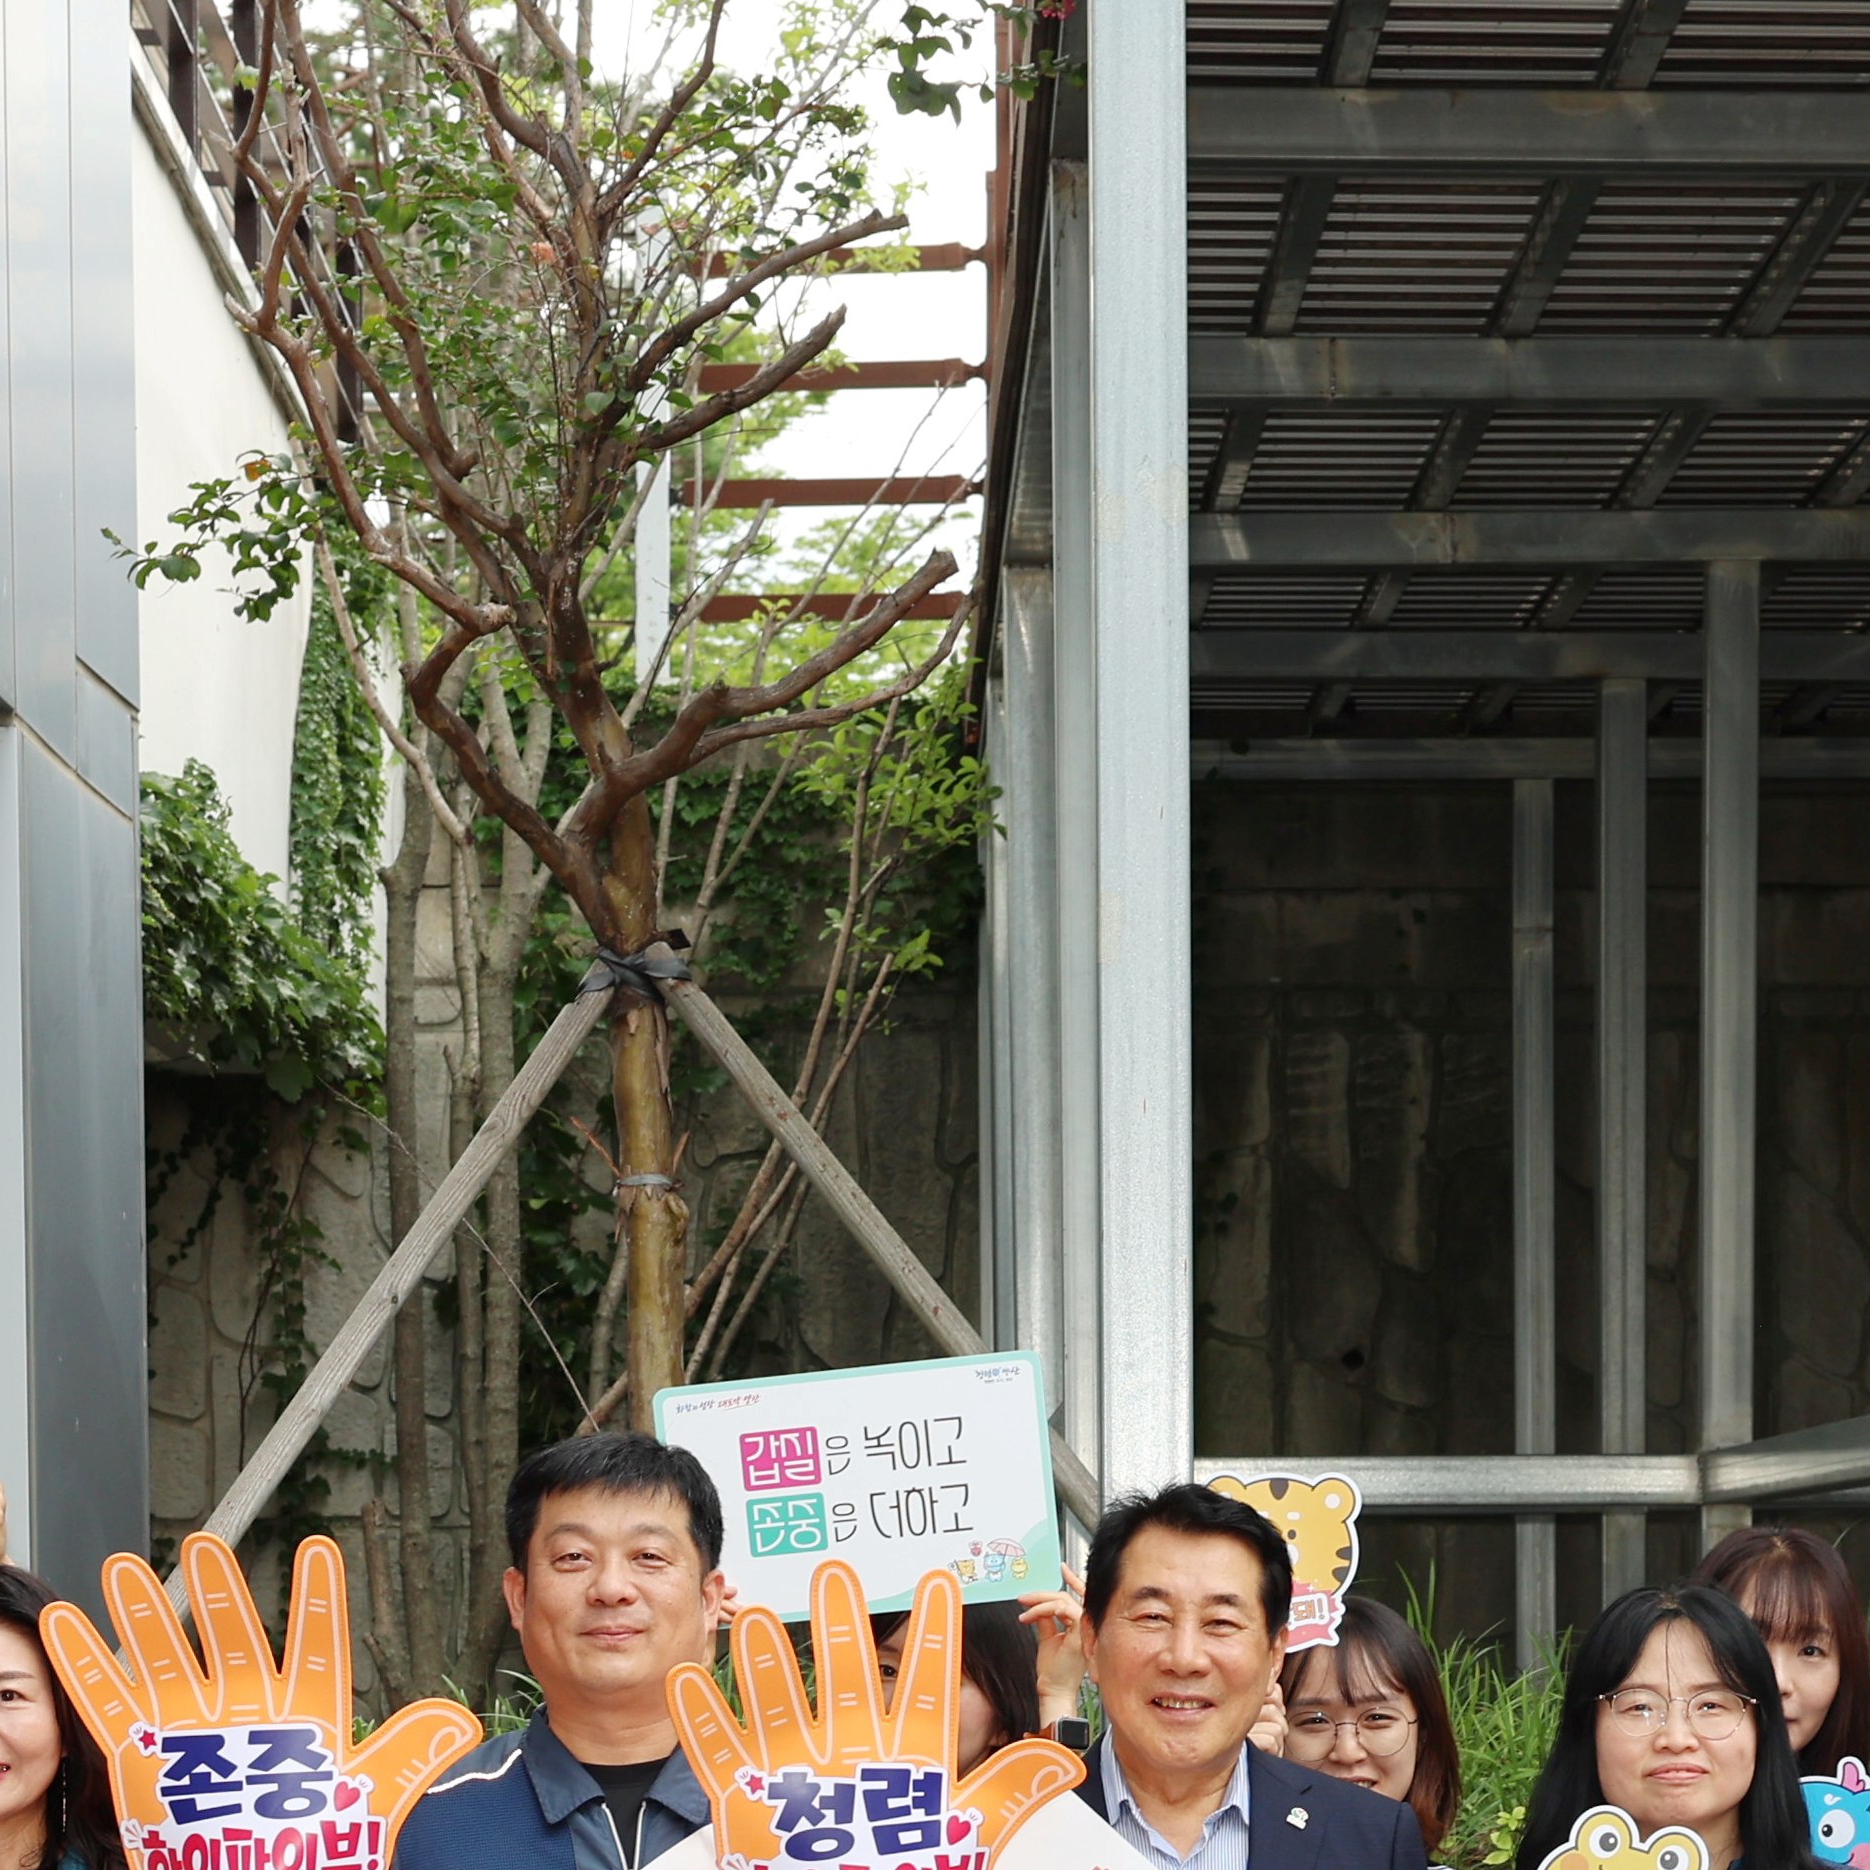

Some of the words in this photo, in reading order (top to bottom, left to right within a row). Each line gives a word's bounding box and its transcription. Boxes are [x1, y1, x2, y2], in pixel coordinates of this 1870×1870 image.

[745, 1430, 851, 1486] 갑질은
[864, 1416, 967, 1470] 녹이고
[752, 1498, 857, 1553] 존중은
[869, 1483, 974, 1539] 더하고
[160, 1729, 334, 1825] 존중
[768, 1768, 943, 1861] 청렴
